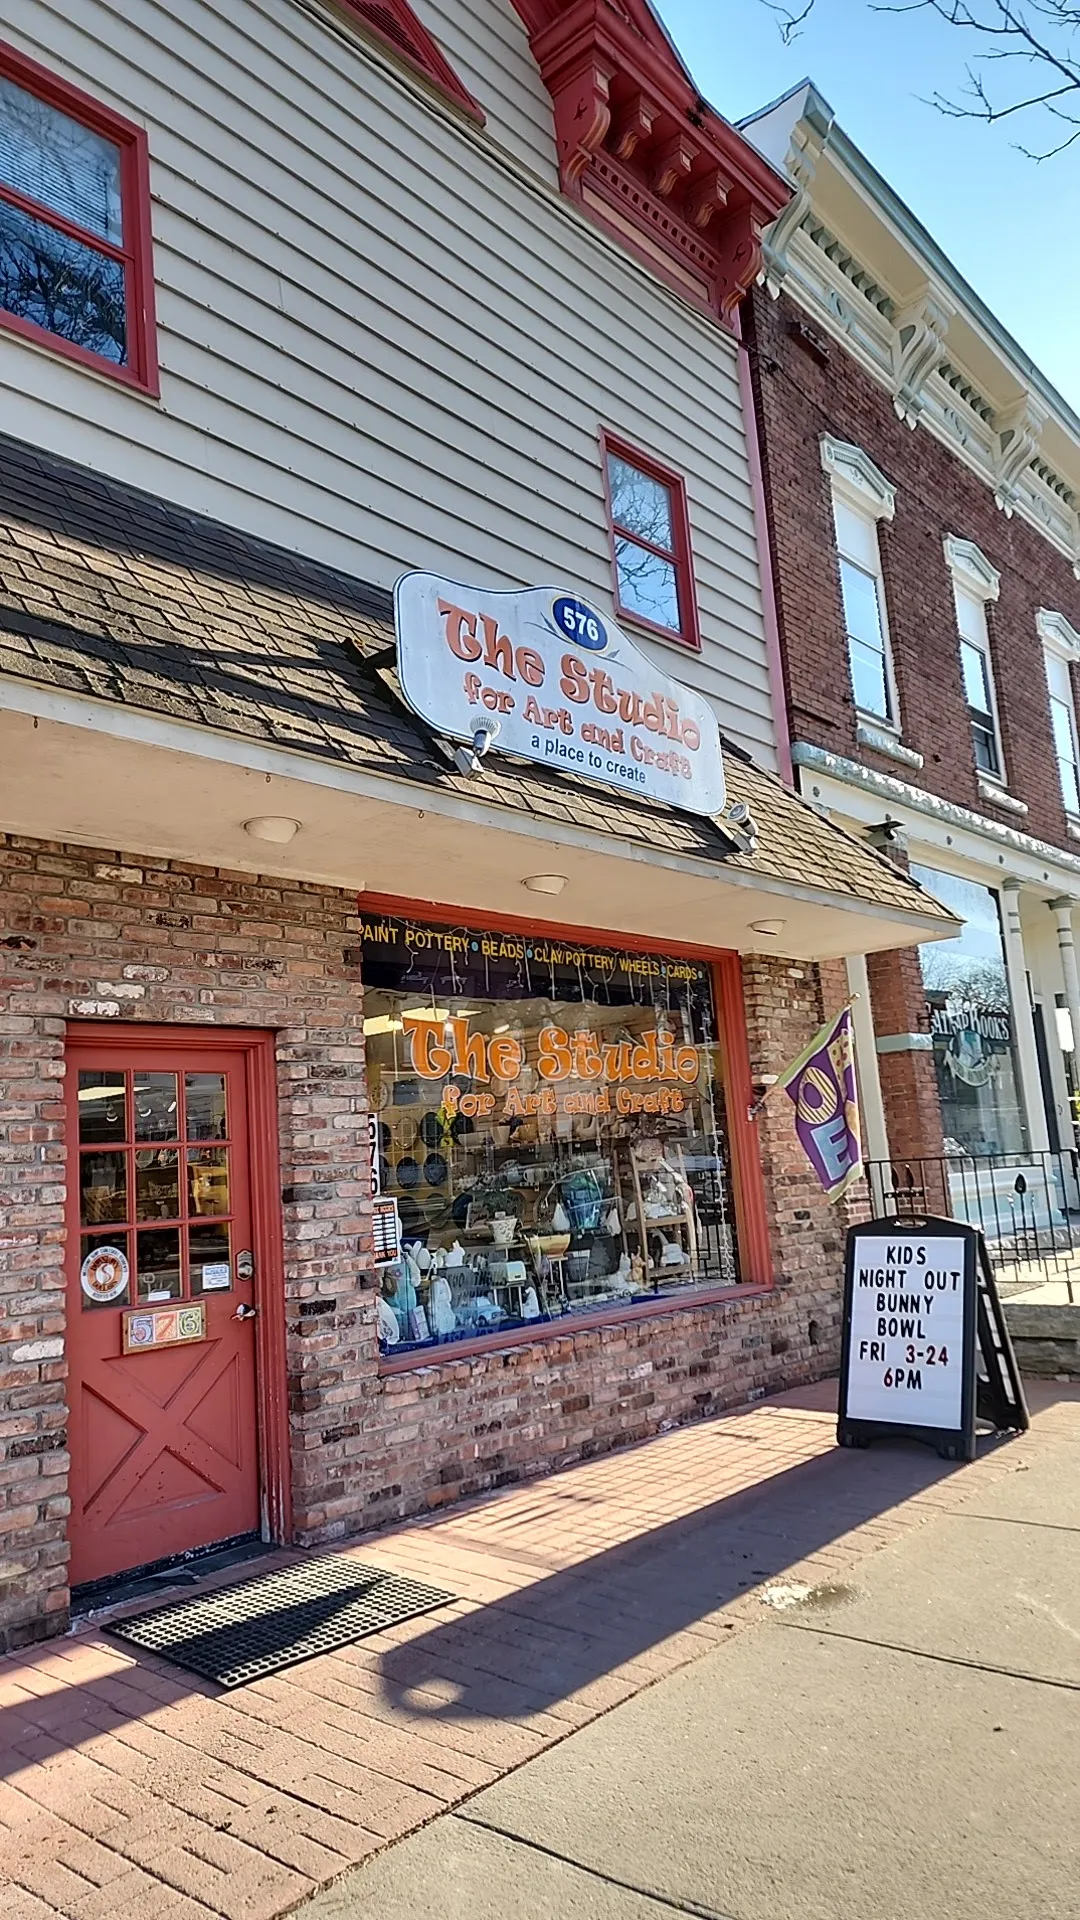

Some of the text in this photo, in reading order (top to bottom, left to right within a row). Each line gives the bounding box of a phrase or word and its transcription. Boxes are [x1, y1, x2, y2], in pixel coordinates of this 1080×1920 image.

[562, 607, 600, 642] 576
[437, 597, 702, 751] The Studio
[463, 671, 693, 780] for Art and Craft
[531, 734, 647, 784] a place to create
[405, 929, 470, 952] POTTERY
[481, 940, 525, 960] BEADS
[534, 947, 615, 970] CLAY/POTTERY
[618, 957, 660, 976] WHEELS
[667, 964, 698, 980] CARDS
[401, 1015, 700, 1084] The Studio
[441, 1085, 686, 1119] for Art and Craft
[367, 1113, 378, 1195] 576
[886, 1245, 926, 1265] KIDS
[859, 1268, 961, 1291] NIGHT OUT
[876, 1292, 934, 1314] BUNNY
[130, 1308, 201, 1345] 576
[877, 1317, 926, 1339] BOWL
[859, 1340, 949, 1367] FRI 3-24
[883, 1366, 922, 1390] 6PM
